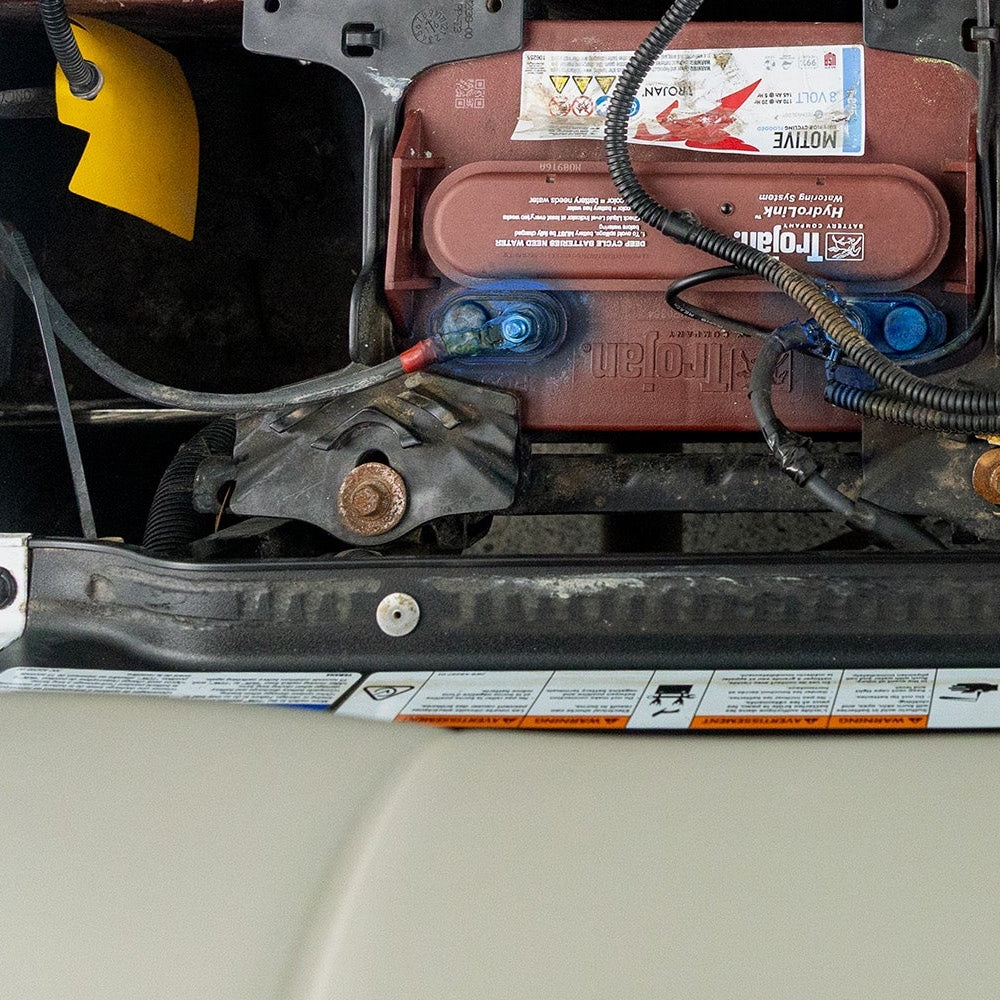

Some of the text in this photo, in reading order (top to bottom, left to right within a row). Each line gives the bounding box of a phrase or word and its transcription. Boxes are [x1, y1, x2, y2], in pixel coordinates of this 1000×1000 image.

[796, 92, 837, 103] 8 VOLT
[773, 131, 836, 149] MOTIVE
[759, 193, 843, 202] Watering System
